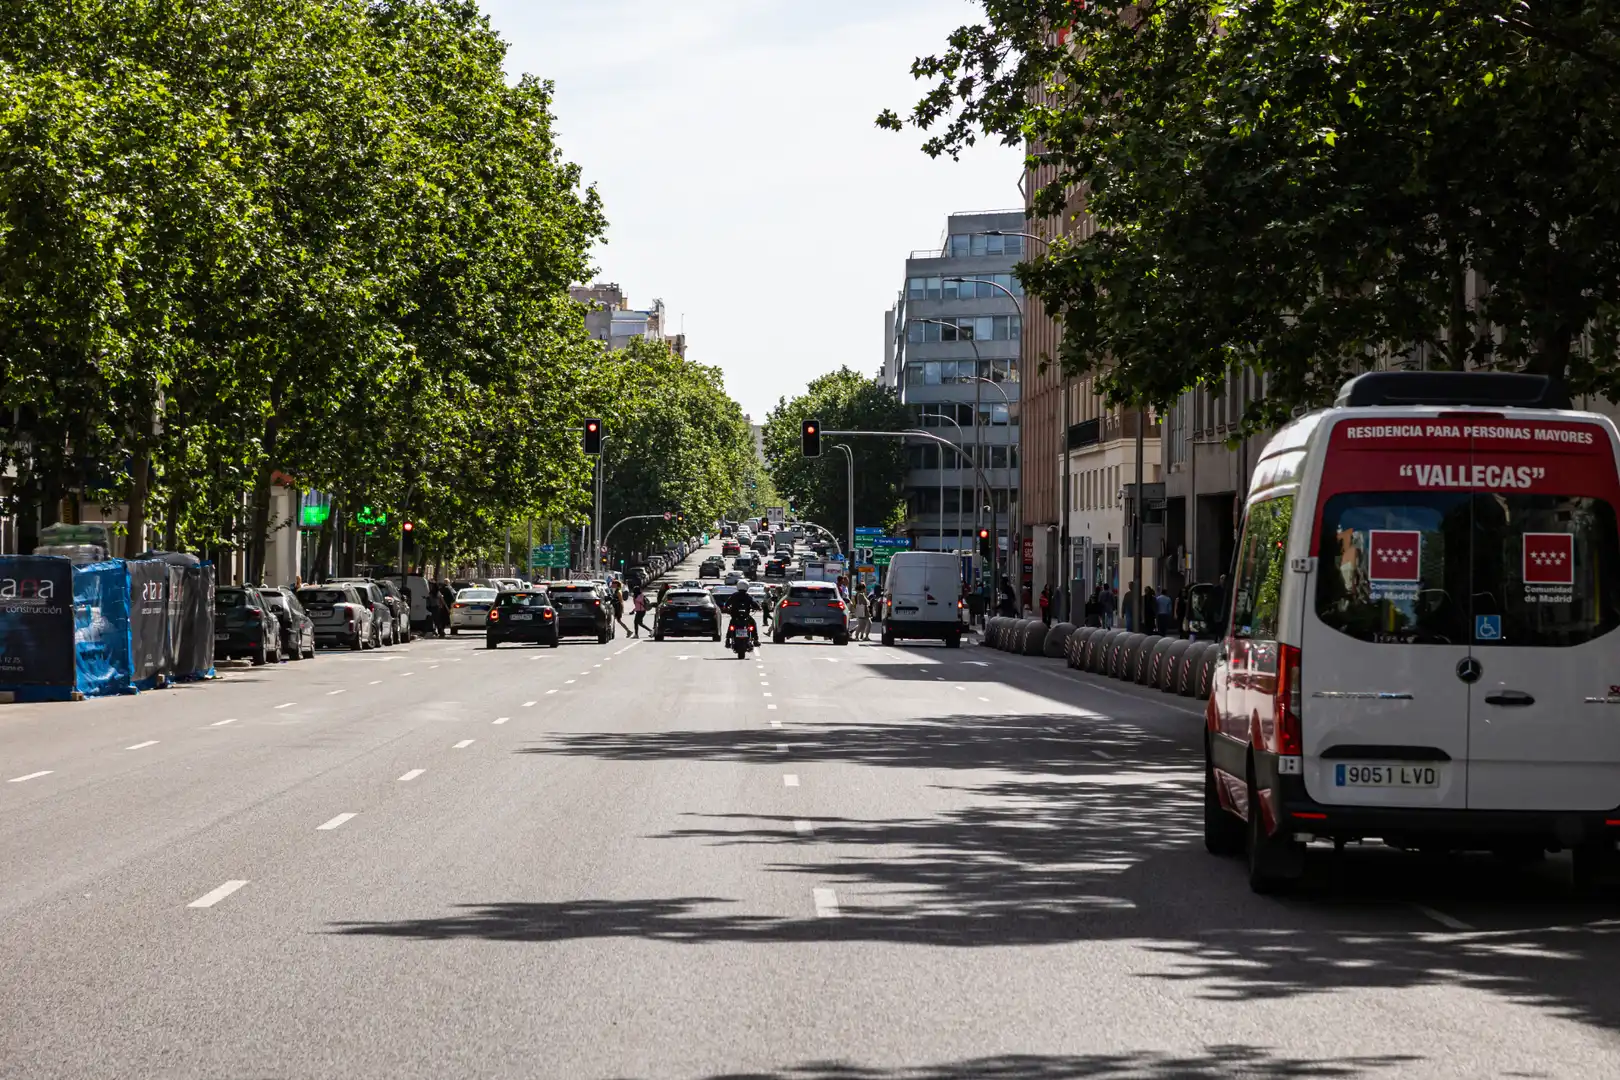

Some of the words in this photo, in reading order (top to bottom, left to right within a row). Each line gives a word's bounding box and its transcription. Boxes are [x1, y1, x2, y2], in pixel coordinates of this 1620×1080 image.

[1347, 425, 1423, 439] RESIDENCIA
[1426, 425, 1460, 437] PARA
[1463, 426, 1531, 440] PERSONAS
[1534, 428, 1593, 445] MAYORES
[1369, 582, 1419, 591] Comunidad
[1524, 585, 1573, 594] Comunidad
[1369, 592, 1381, 600] de
[1384, 591, 1419, 600] Madrid
[1524, 595, 1537, 603] de
[1539, 594, 1573, 603] Madrid
[1349, 767, 1392, 783] 9051
[1401, 767, 1434, 784] LVD
